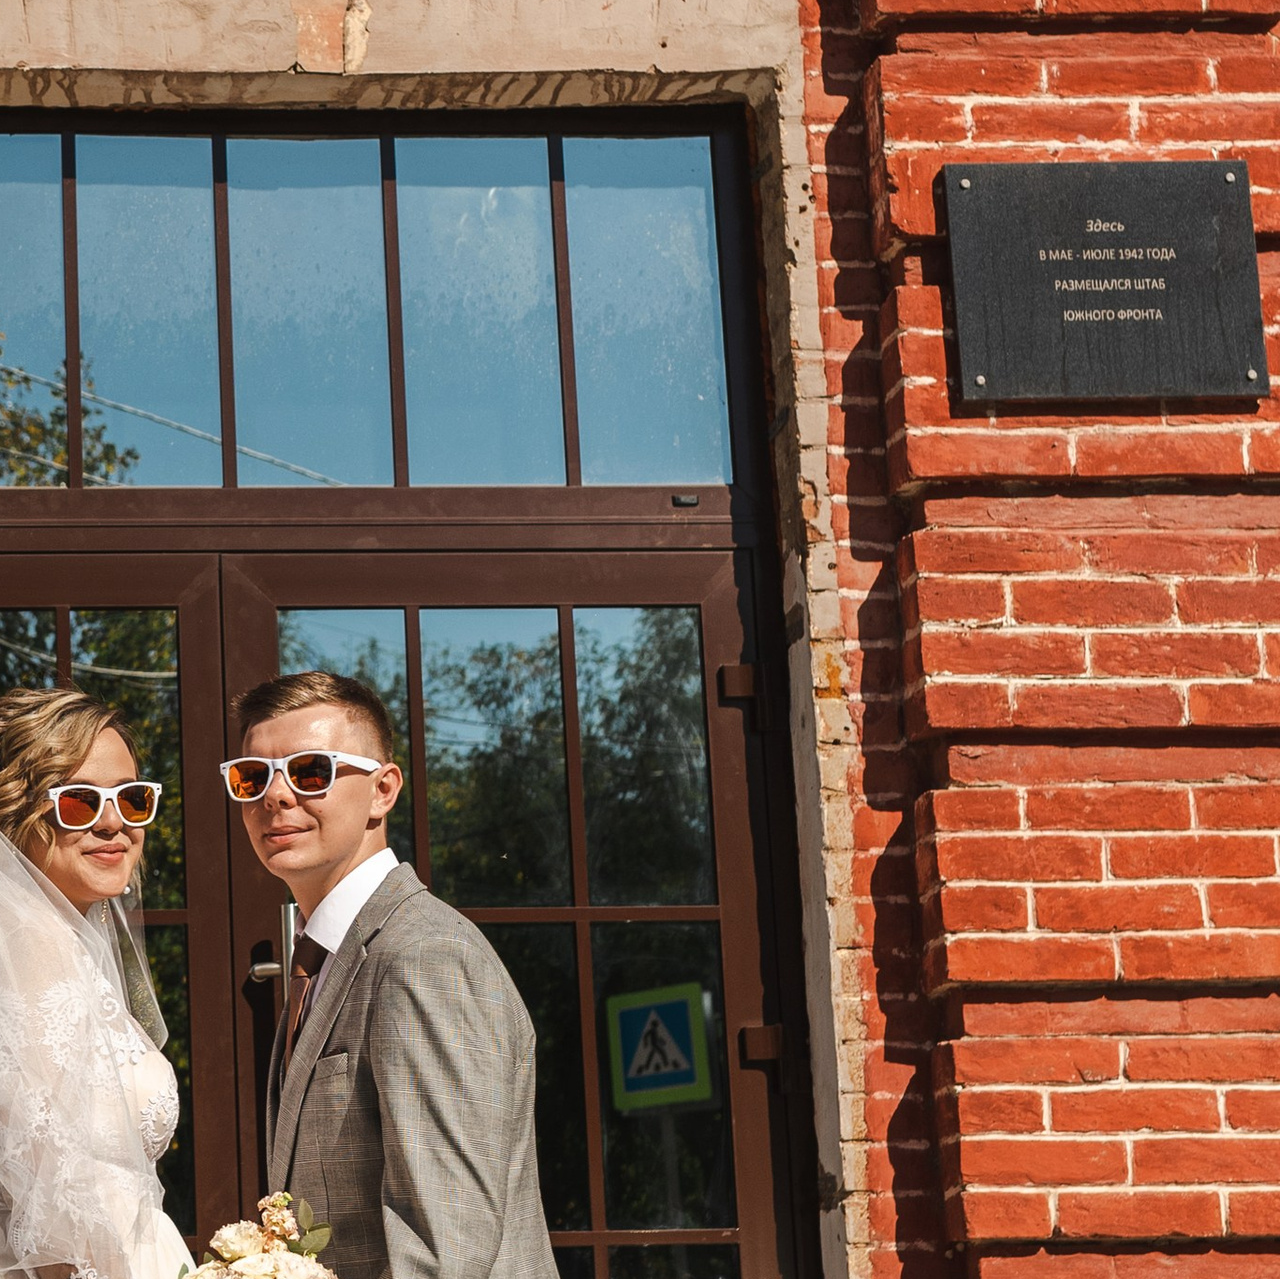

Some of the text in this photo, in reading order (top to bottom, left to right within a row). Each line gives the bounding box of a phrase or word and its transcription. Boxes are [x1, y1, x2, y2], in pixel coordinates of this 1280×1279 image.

[1085, 220, 1125, 233] Здесь
[1039, 250, 1047, 260] В
[1049, 250, 1073, 260] МАЕ
[1082, 249, 1116, 260] ИЮЛЕ
[1119, 249, 1144, 260] 1942
[1147, 249, 1176, 261] ГОДА
[1055, 279, 1165, 292] РАЗМЕЩАЛСЯ ШТАБ
[1063, 309, 1163, 321] ЮЖНОГО ФРОНТА
